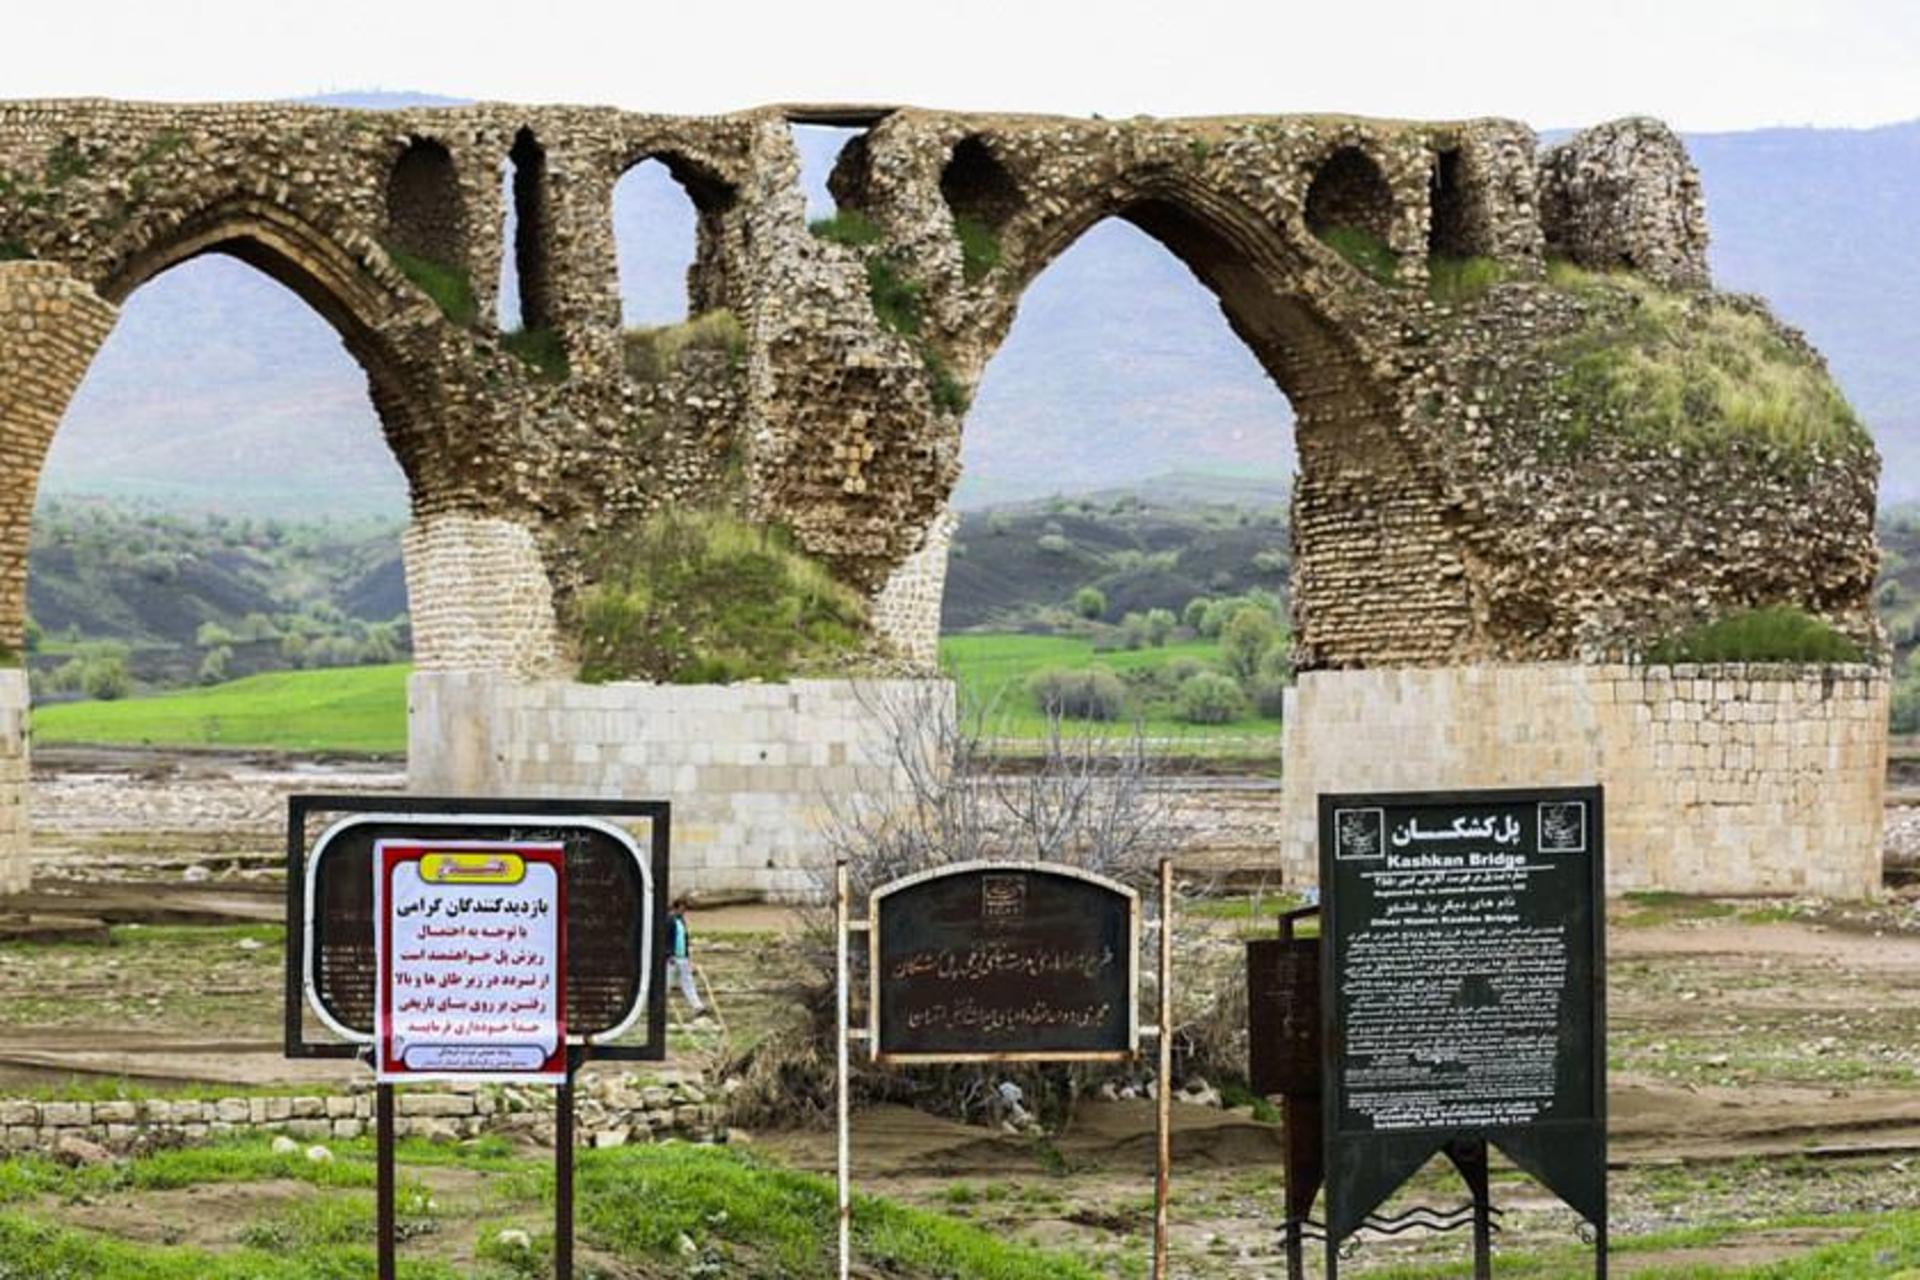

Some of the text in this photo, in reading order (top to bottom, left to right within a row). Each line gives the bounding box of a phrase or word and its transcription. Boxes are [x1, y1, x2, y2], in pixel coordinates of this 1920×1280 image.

[1494, 815, 1521, 845] پل
[1388, 853, 1526, 870] Kashkan Bridge
[397, 898, 443, 917] گرامی
[401, 946, 425, 962] است
[495, 949, 509, 966] پل
[486, 975, 499, 988] در
